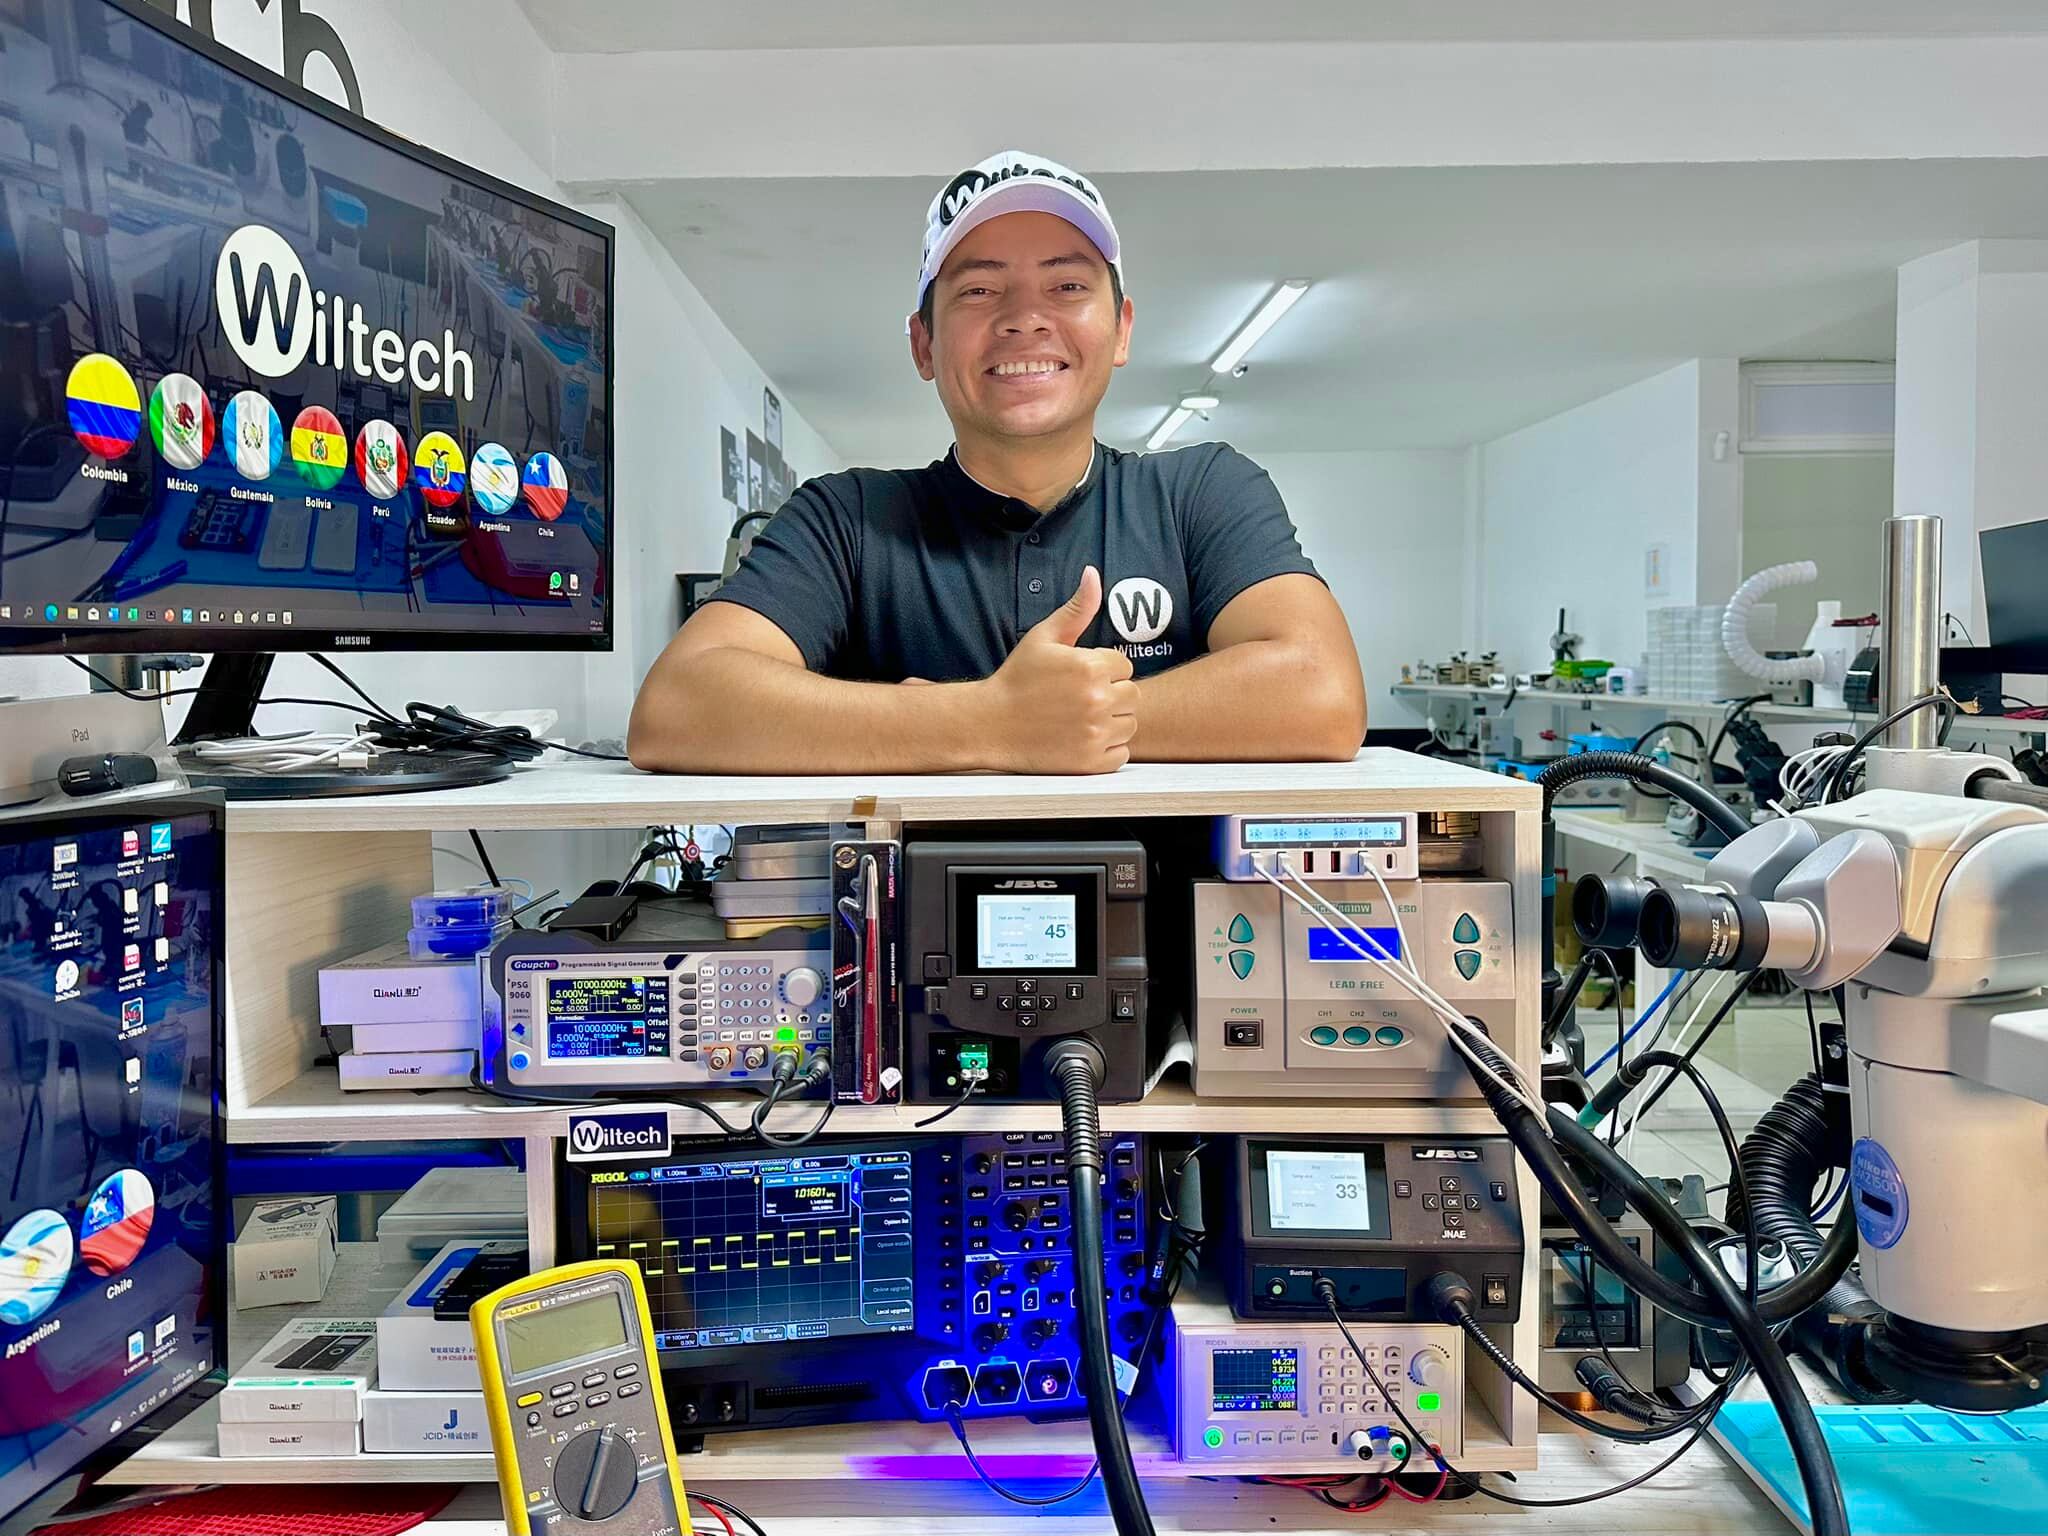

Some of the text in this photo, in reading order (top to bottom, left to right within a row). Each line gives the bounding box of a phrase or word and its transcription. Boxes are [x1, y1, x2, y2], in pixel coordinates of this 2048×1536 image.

[218, 228, 474, 401] Wiltech
[81, 463, 128, 483] Colombia
[167, 477, 199, 493] México
[230, 486, 274, 503] Guatemala
[305, 496, 332, 510] Bolivia
[373, 505, 390, 517] Perú
[427, 513, 456, 526] Ecuador
[479, 520, 511, 533] Argentina
[538, 527, 554, 538] Chile
[1112, 584, 1165, 637] W
[335, 635, 371, 646] SAMSUNG
[1113, 641, 1173, 658] Wiltech
[71, 728, 90, 743] iPad
[1115, 864, 1136, 872] JTSE
[888, 878, 896, 898] MATA
[994, 880, 1058, 889] JBC
[1045, 923, 1066, 939] 45
[1207, 941, 1229, 949] TEMP
[561, 961, 607, 969] Programmable
[607, 961, 627, 969] Signal
[628, 960, 660, 968] Generator
[511, 981, 529, 989] PSG
[1330, 980, 1385, 989] LEAD FREE
[509, 991, 531, 999] 9060
[647, 1018, 669, 1026] Offset
[651, 1031, 666, 1040] Duty
[574, 1122, 661, 1150] Wiltech
[1415, 1149, 1479, 1159] JBC
[1857, 1155, 1889, 1179] Nikon
[591, 1171, 628, 1183] RIGOL
[1336, 1183, 1358, 1199] 33
[1441, 1230, 1467, 1239] JNAE
[106, 1276, 133, 1300] Chile
[5, 1318, 61, 1359] Argentina
[547, 1514, 561, 1525] OFF
